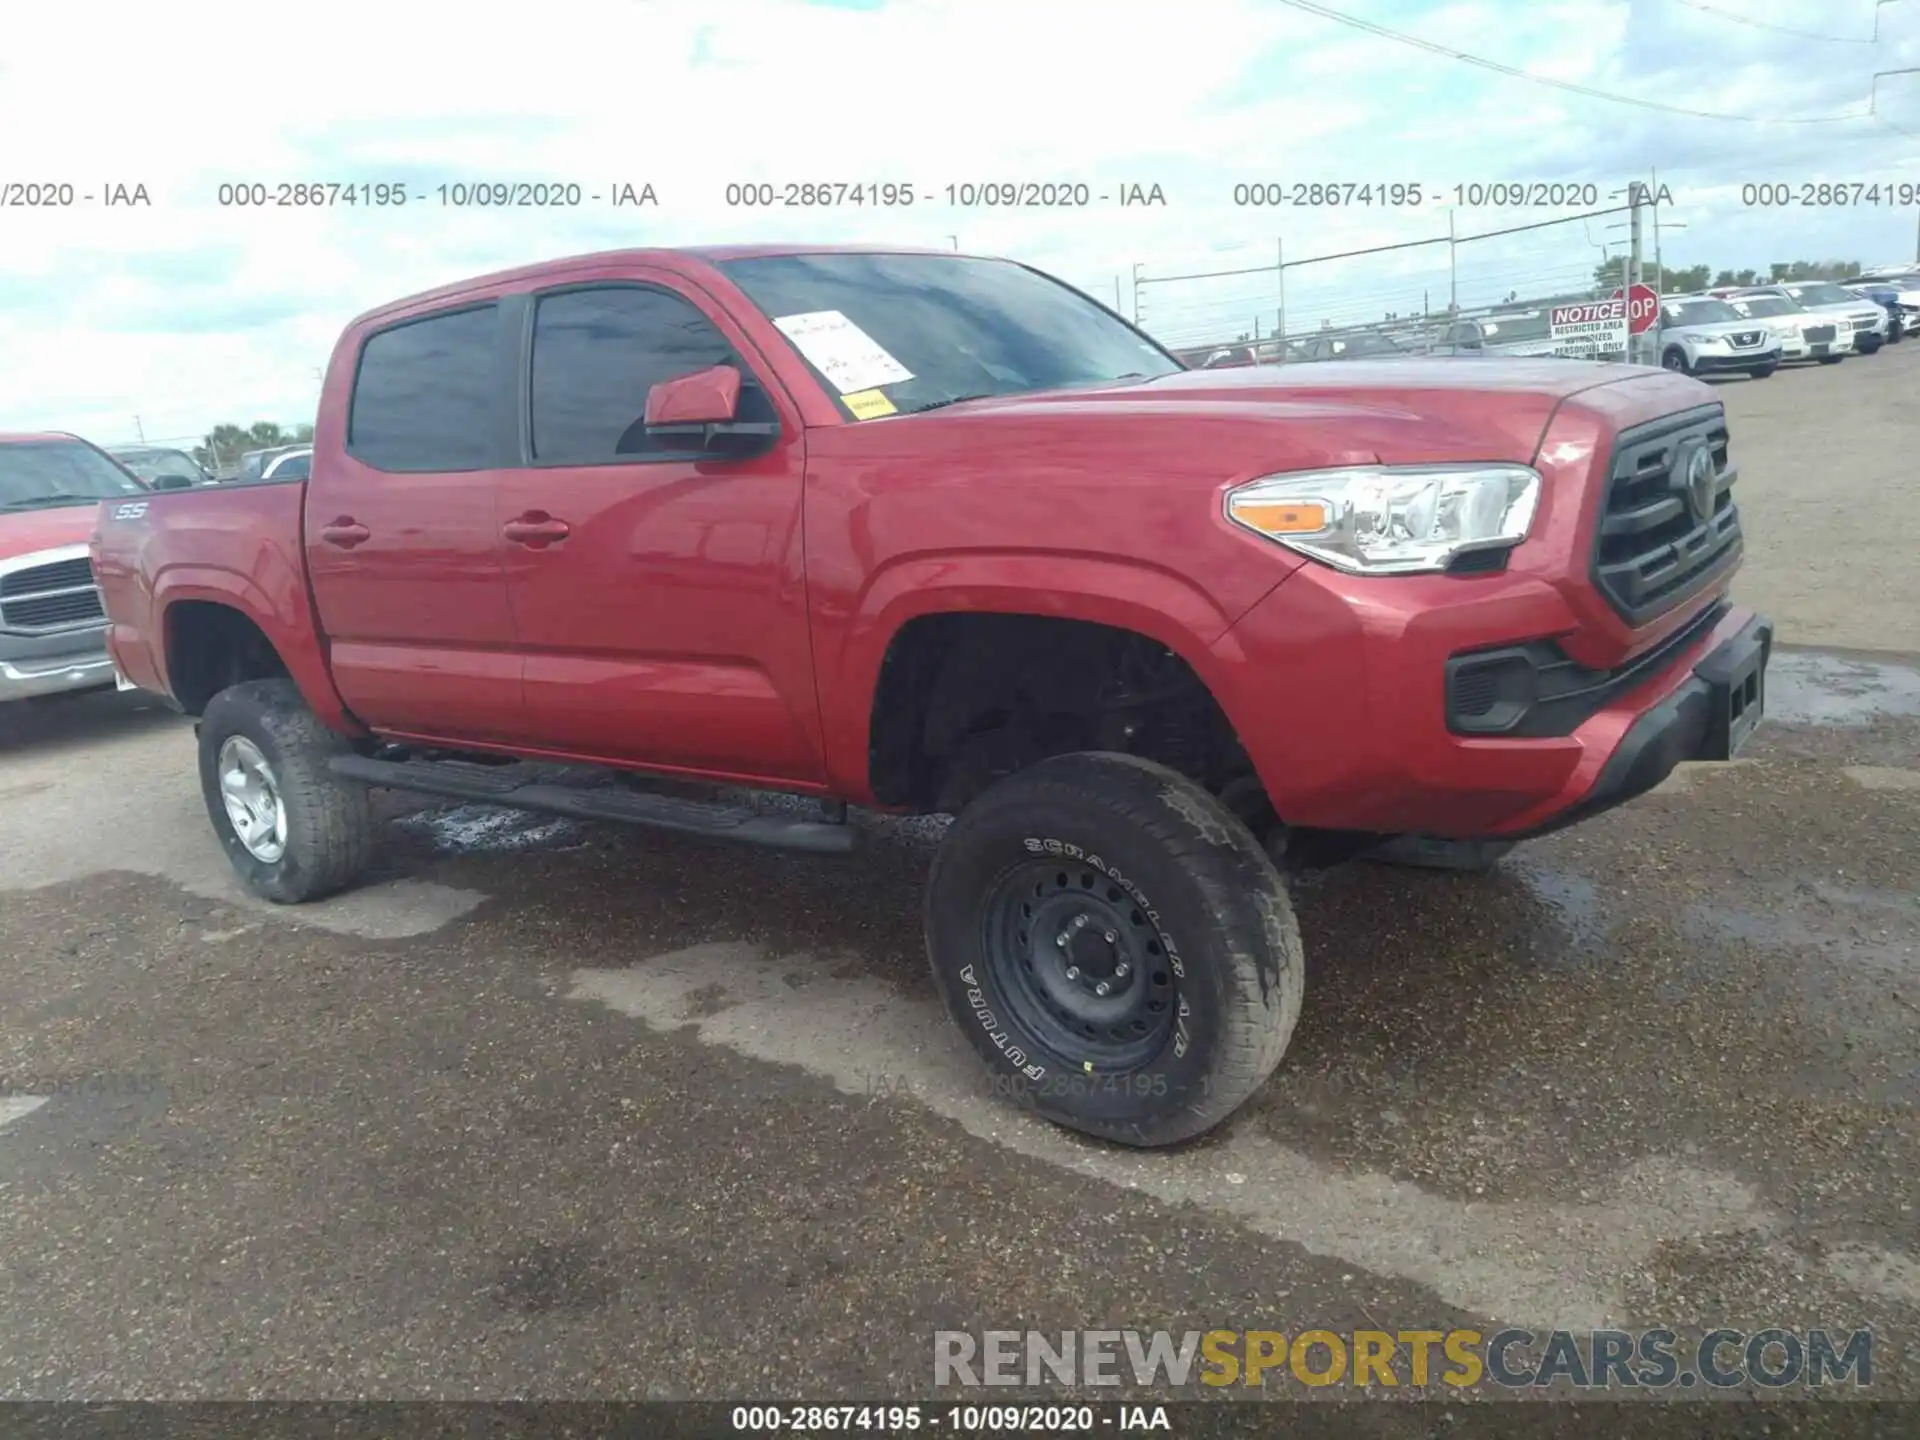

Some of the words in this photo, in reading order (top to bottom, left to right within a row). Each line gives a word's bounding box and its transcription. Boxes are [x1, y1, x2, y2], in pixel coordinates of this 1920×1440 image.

[1555, 302, 1625, 324] NOTICE
[1630, 298, 1655, 319] OP
[1554, 320, 1602, 335] RESTRICTED
[1603, 318, 1624, 332] AREA
[1602, 339, 1625, 354] ONLY
[1023, 837, 1185, 978] SCRAMBLER
[959, 963, 1046, 1081] FUTURA
